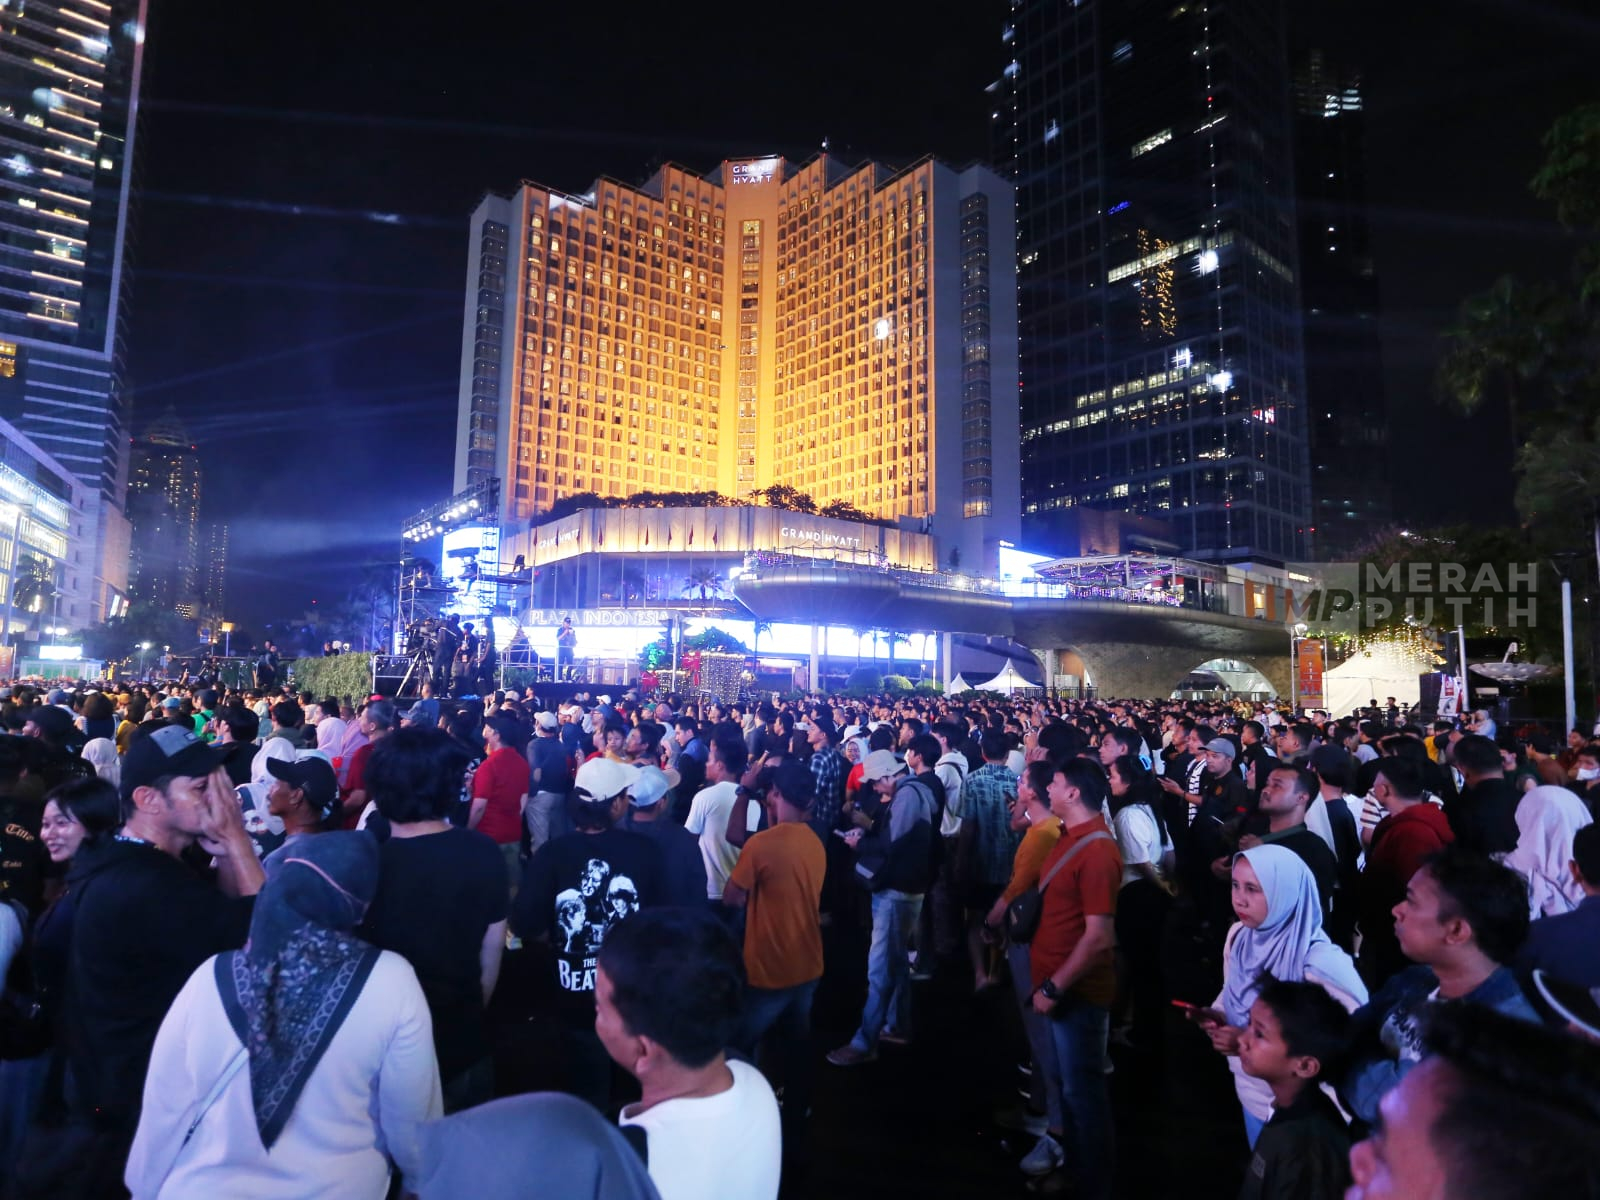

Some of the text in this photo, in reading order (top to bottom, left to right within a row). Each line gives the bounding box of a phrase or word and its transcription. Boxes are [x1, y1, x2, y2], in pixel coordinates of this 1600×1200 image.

[733, 175, 772, 185] HYATT
[781, 527, 860, 547] GRAND HYATT
[583, 610, 670, 625] INDONESIA
[583, 958, 597, 968] THE
